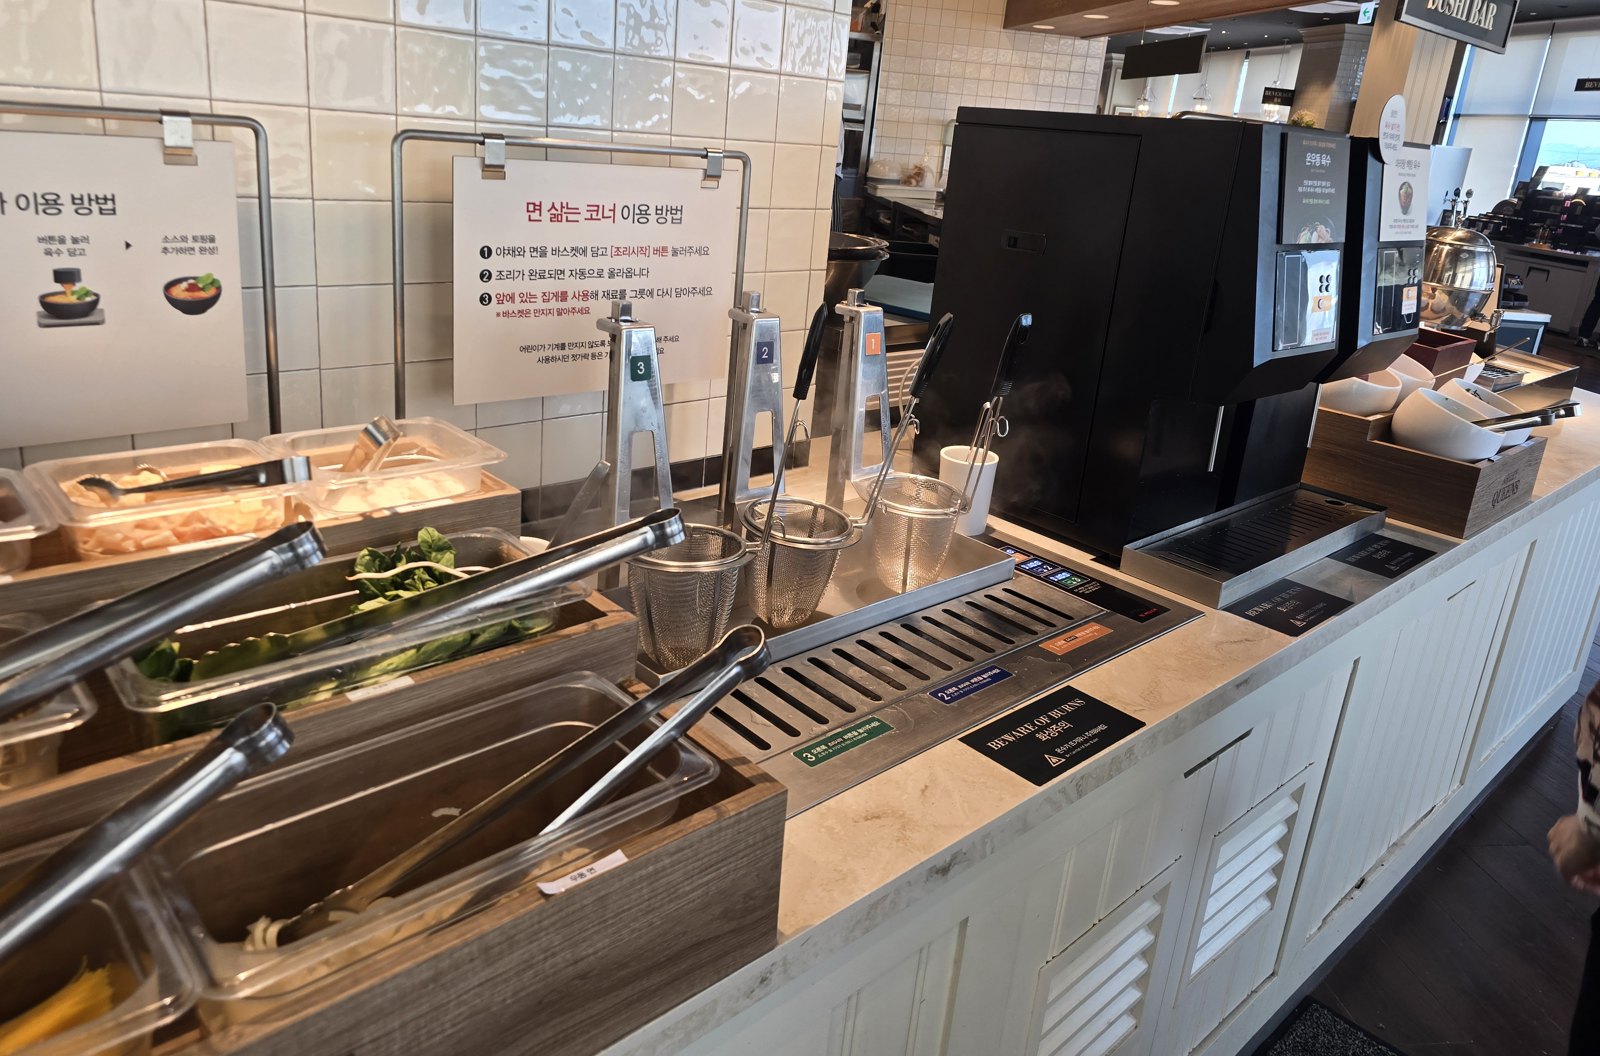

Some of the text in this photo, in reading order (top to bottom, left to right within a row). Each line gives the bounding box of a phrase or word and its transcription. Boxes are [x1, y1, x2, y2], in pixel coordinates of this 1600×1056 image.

[1468, 0, 1497, 30] BAR
[15, 191, 64, 216] 이용
[70, 192, 117, 216] 방법
[526, 201, 683, 224] 면 삶는 코너 이용 방법
[161, 234, 189, 244] 소스와
[161, 246, 196, 256] 추가하면
[496, 246, 526, 258] 야채와
[529, 246, 548, 258] 면을
[552, 246, 588, 258] 바스켓에
[590, 246, 608, 258] 담고
[610, 245, 650, 258] [조리시작]
[652, 246, 669, 257] 버튼
[672, 246, 710, 256] 눌러주세요
[495, 268, 525, 281] 조리가
[528, 268, 566, 280] 완료되면
[568, 268, 605, 280] 자동으로
[608, 268, 650, 279] 올라옵니다
[495, 292, 516, 304] 앞에
[518, 292, 538, 304] 있는
[541, 290, 568, 302] 집게를
[571, 290, 598, 302] 사용해
[601, 288, 627, 300] 재료를
[629, 288, 654, 300] 그릇에
[656, 287, 672, 298] 다시
[674, 286, 712, 298] 담아주세요
[502, 308, 532, 318] 바스켓은
[534, 308, 554, 318] 만지지
[556, 306, 590, 316] 말아주세요
[520, 344, 546, 354] 어린이가
[547, 342, 566, 352] 기계를
[568, 341, 586, 350] 만지지
[588, 340, 606, 349] 않도록
[662, 336, 680, 344] 주세요
[871, 338, 875, 350] 1
[537, 354, 570, 364] 사용하시던
[571, 352, 590, 362] 젓가락
[762, 346, 768, 358] 2
[637, 362, 645, 374] 3
[938, 692, 951, 700] 2
[986, 698, 1086, 750] BEWARE OF BURNS
[1036, 720, 1074, 742] 화상주의
[802, 752, 816, 762] 3
